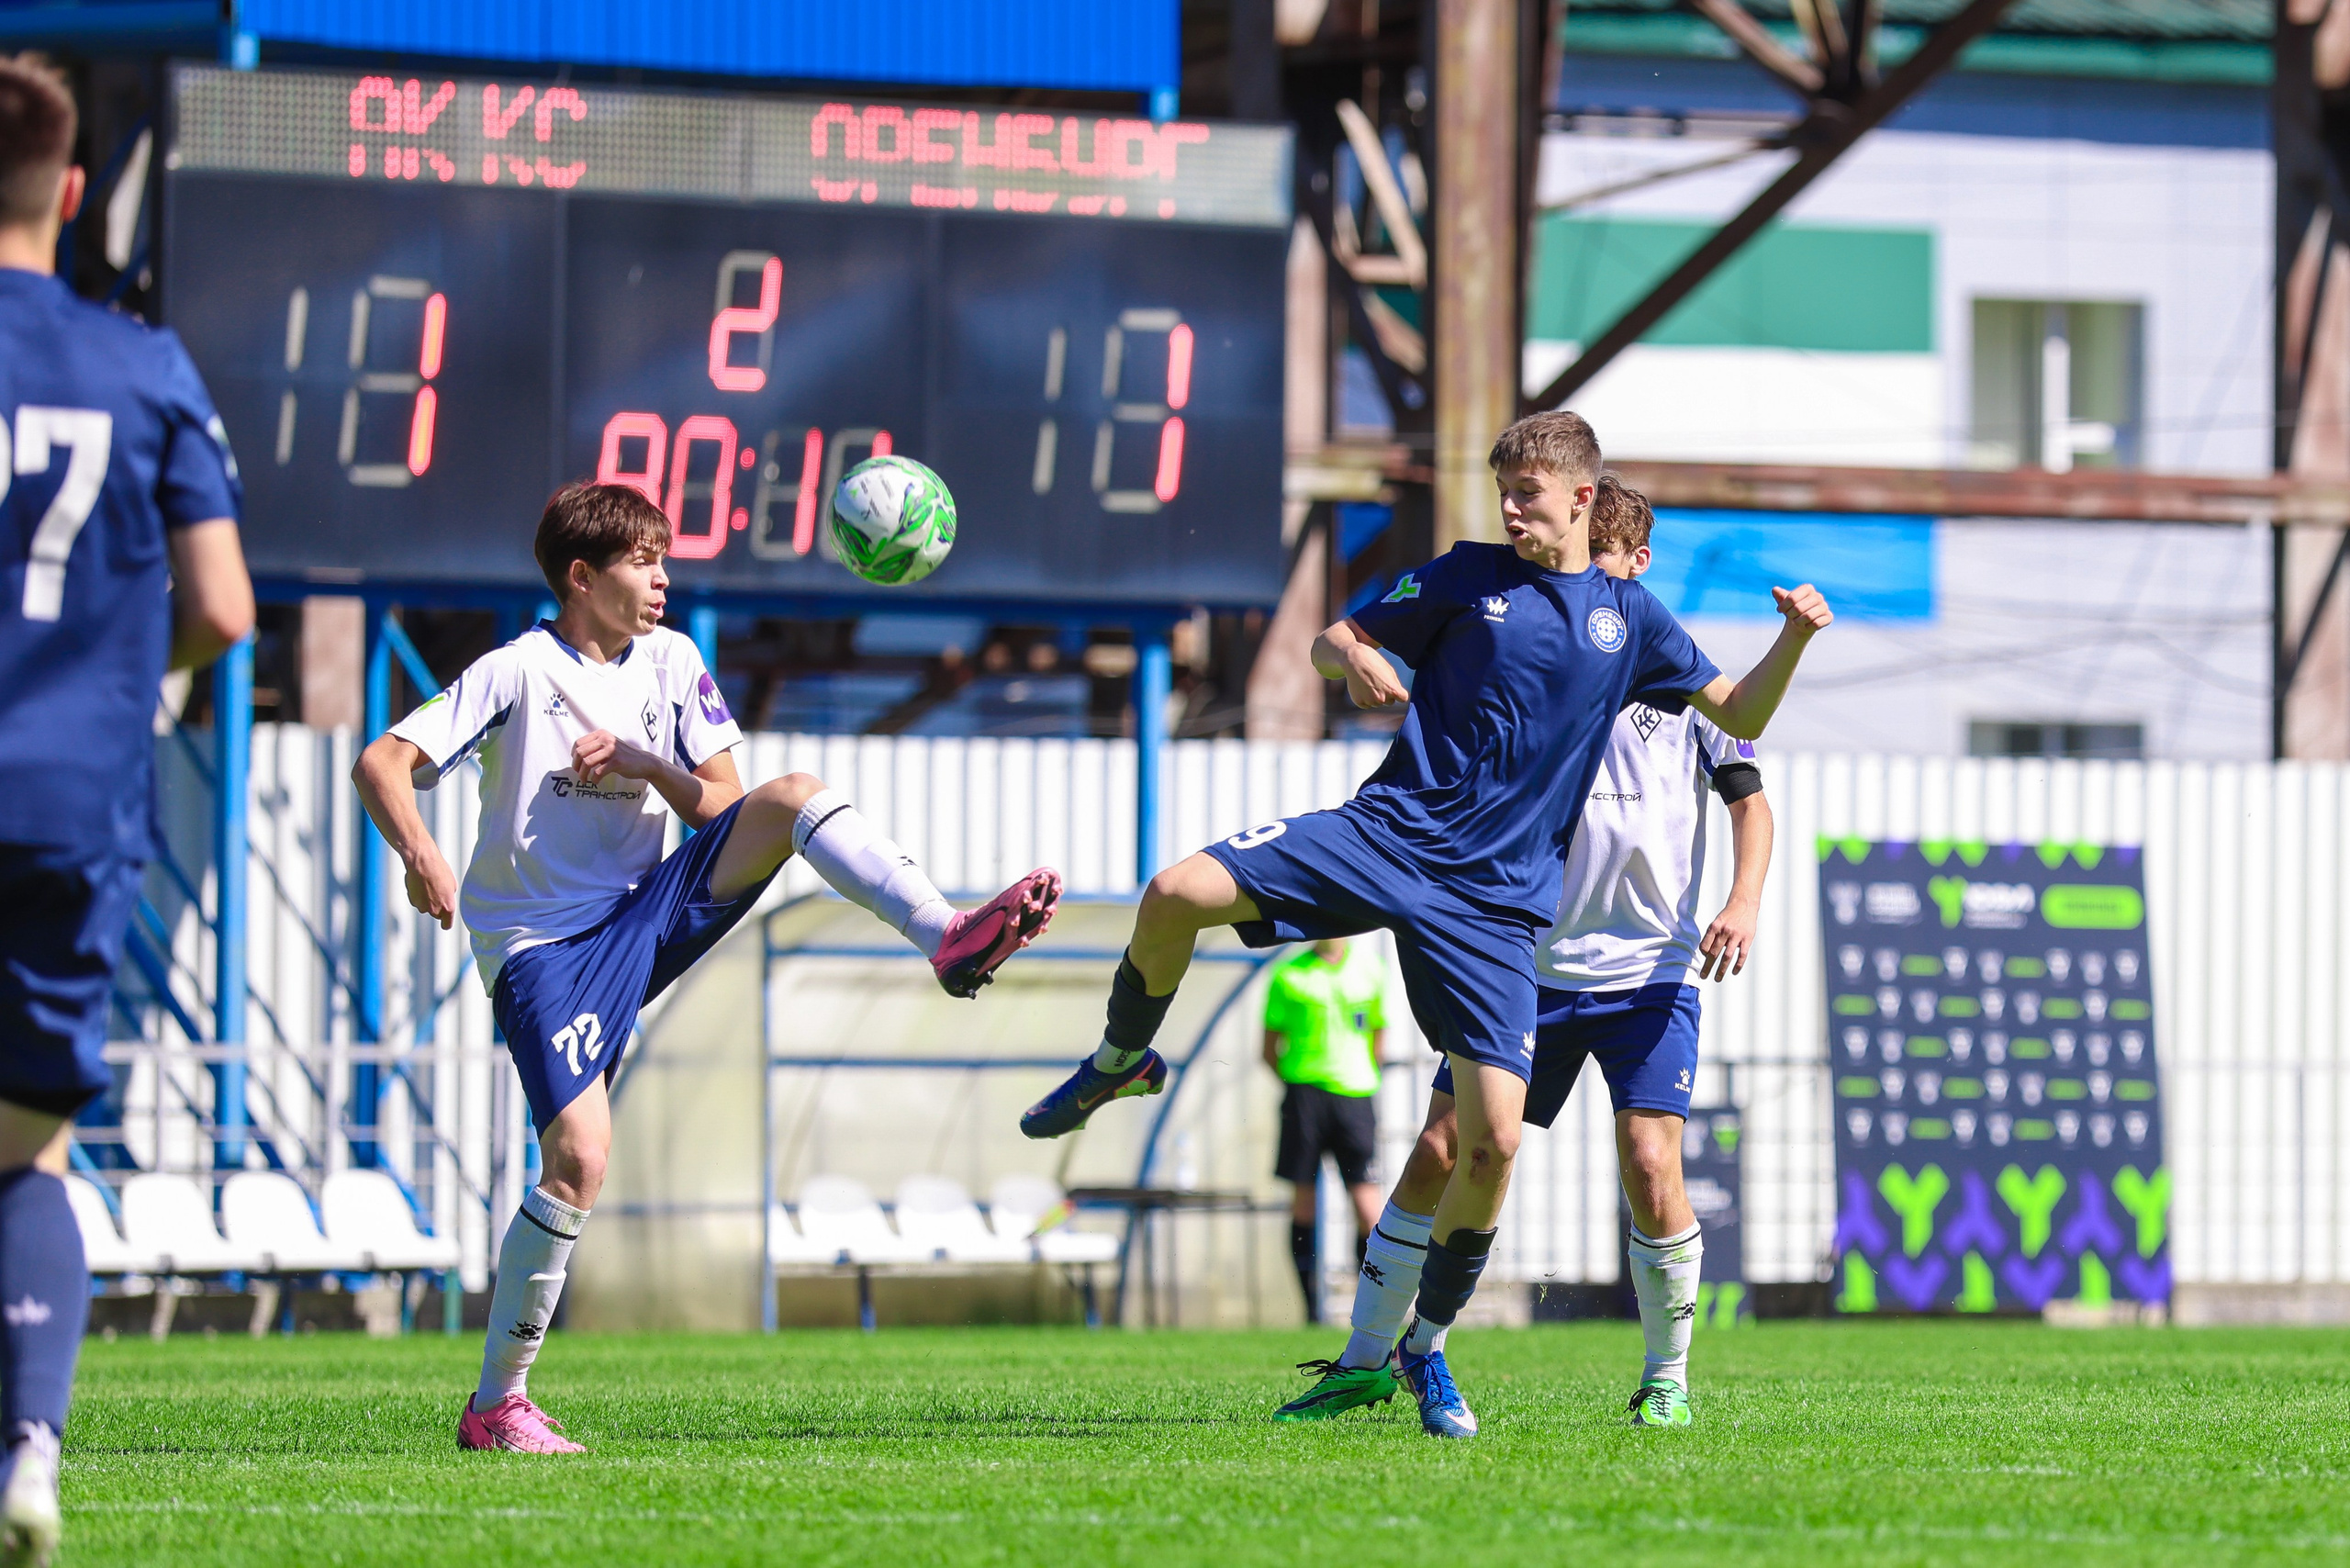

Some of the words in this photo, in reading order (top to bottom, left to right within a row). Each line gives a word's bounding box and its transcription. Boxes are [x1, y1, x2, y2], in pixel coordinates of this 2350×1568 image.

[482, 84, 588, 189] КС
[811, 103, 1210, 219] ОРЕНБУРГ
[709, 256, 783, 392] 2
[408, 292, 448, 476] 1
[1155, 323, 1193, 502] 1
[0, 404, 113, 623] 7
[1591, 610, 1624, 632] ОРЕНБУРГ
[543, 709, 569, 718] KELME
[576, 789, 642, 801] ТРАНССТРОЙ
[1227, 820, 1287, 850] 9
[551, 1013, 605, 1077] 72
